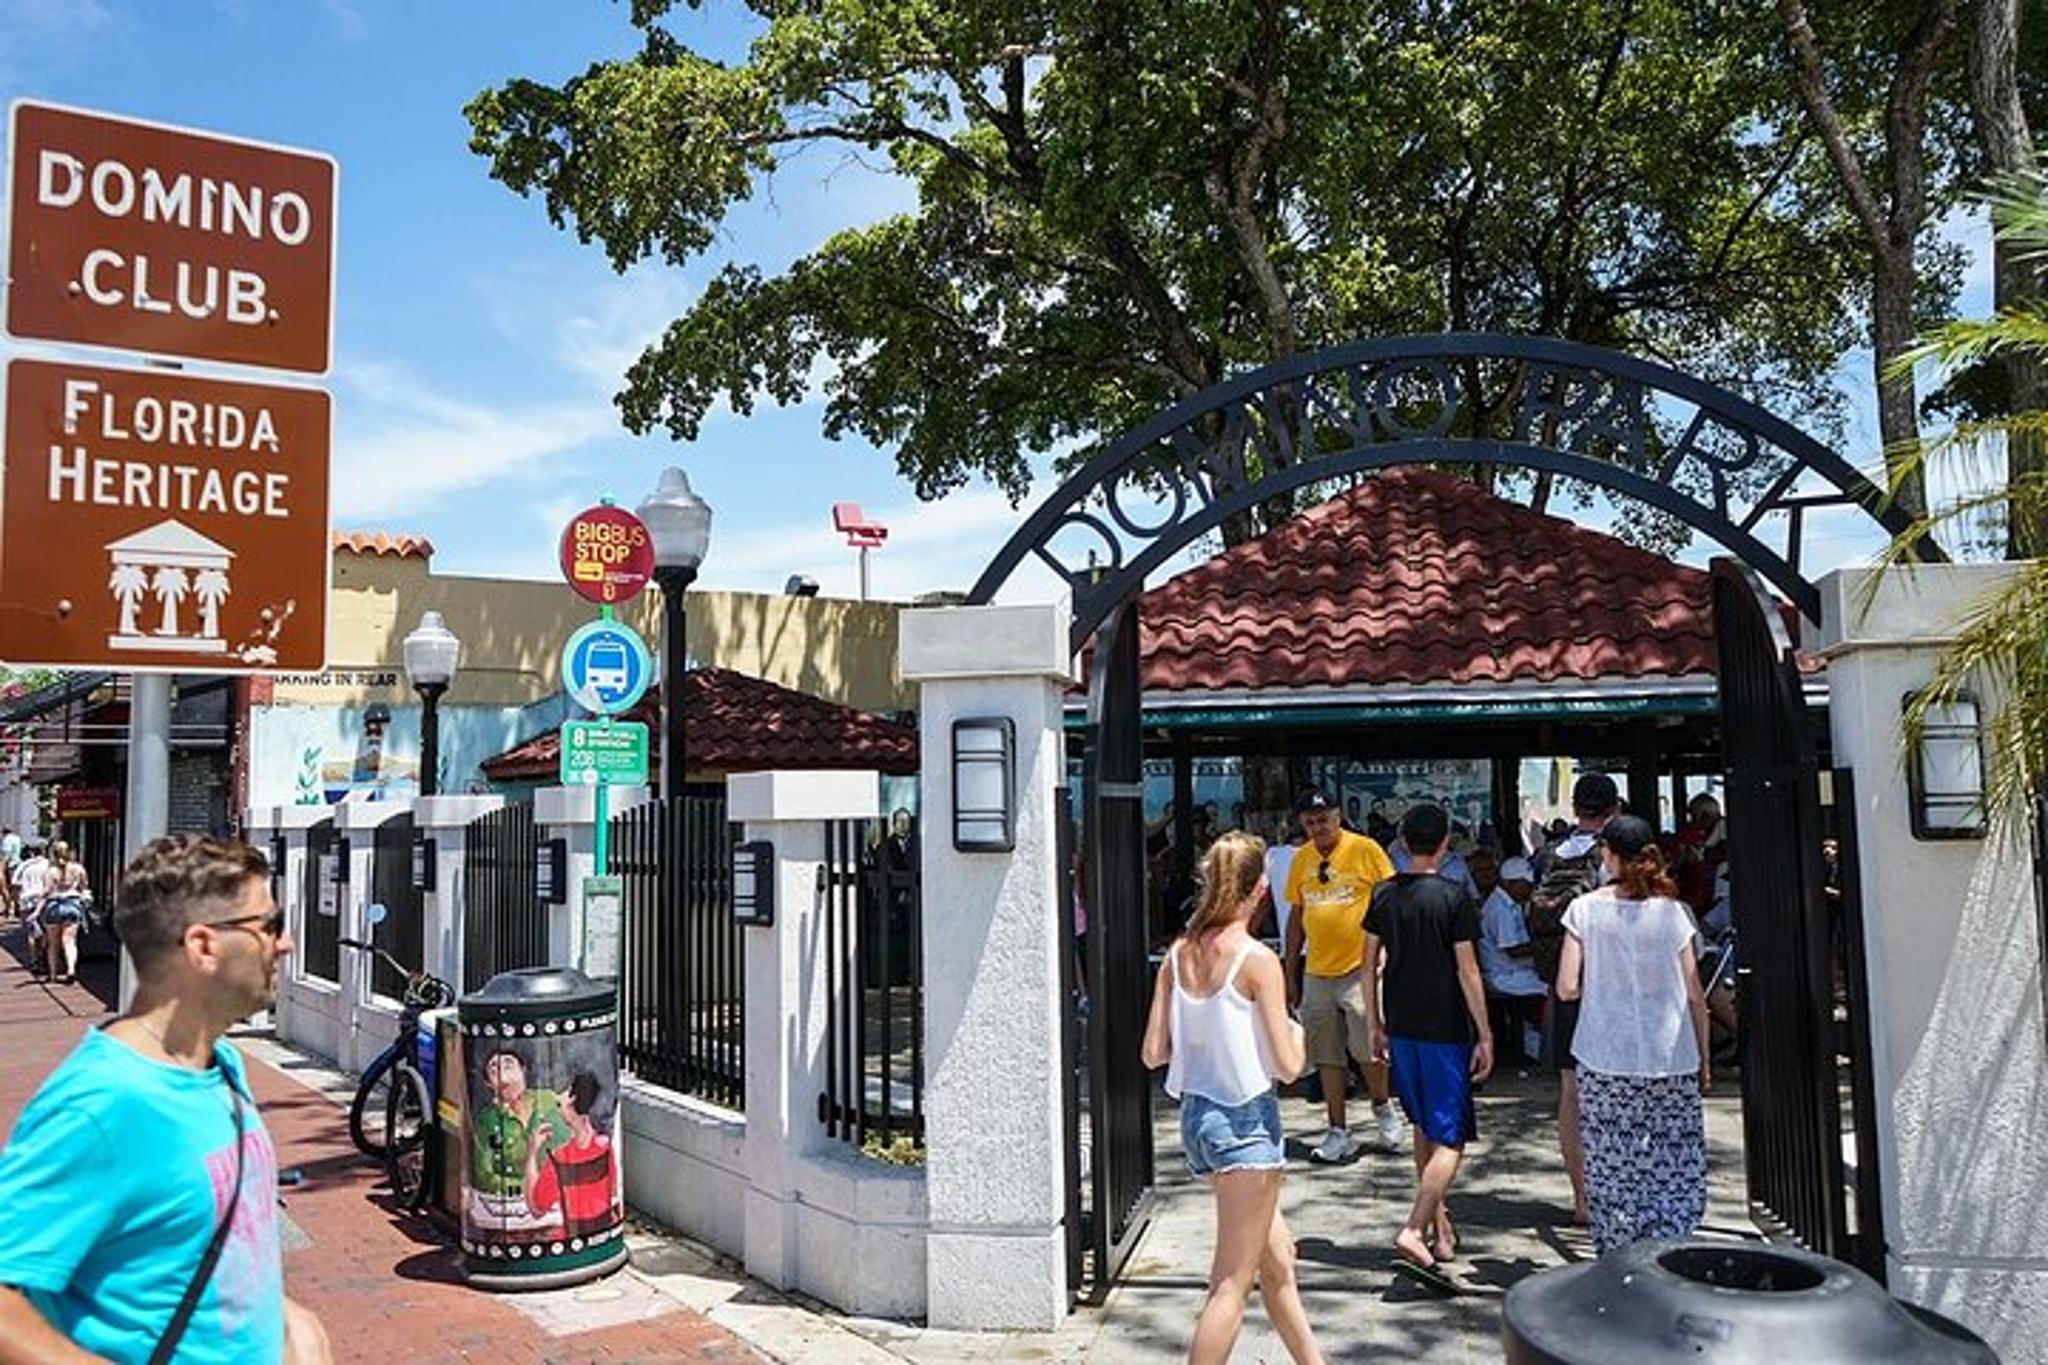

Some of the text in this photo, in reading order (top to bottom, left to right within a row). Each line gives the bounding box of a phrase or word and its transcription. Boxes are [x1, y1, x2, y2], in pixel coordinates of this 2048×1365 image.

[38, 149, 310, 246] DOMINO
[81, 249, 267, 325] CLUB
[64, 379, 279, 453] FLORIDA
[49, 445, 289, 517] HERITAGE
[1032, 357, 1852, 585] DOMINO PARK
[576, 542, 630, 563] STOP
[336, 673, 351, 687] IN
[356, 673, 398, 687] REAR
[573, 727, 586, 748] 8
